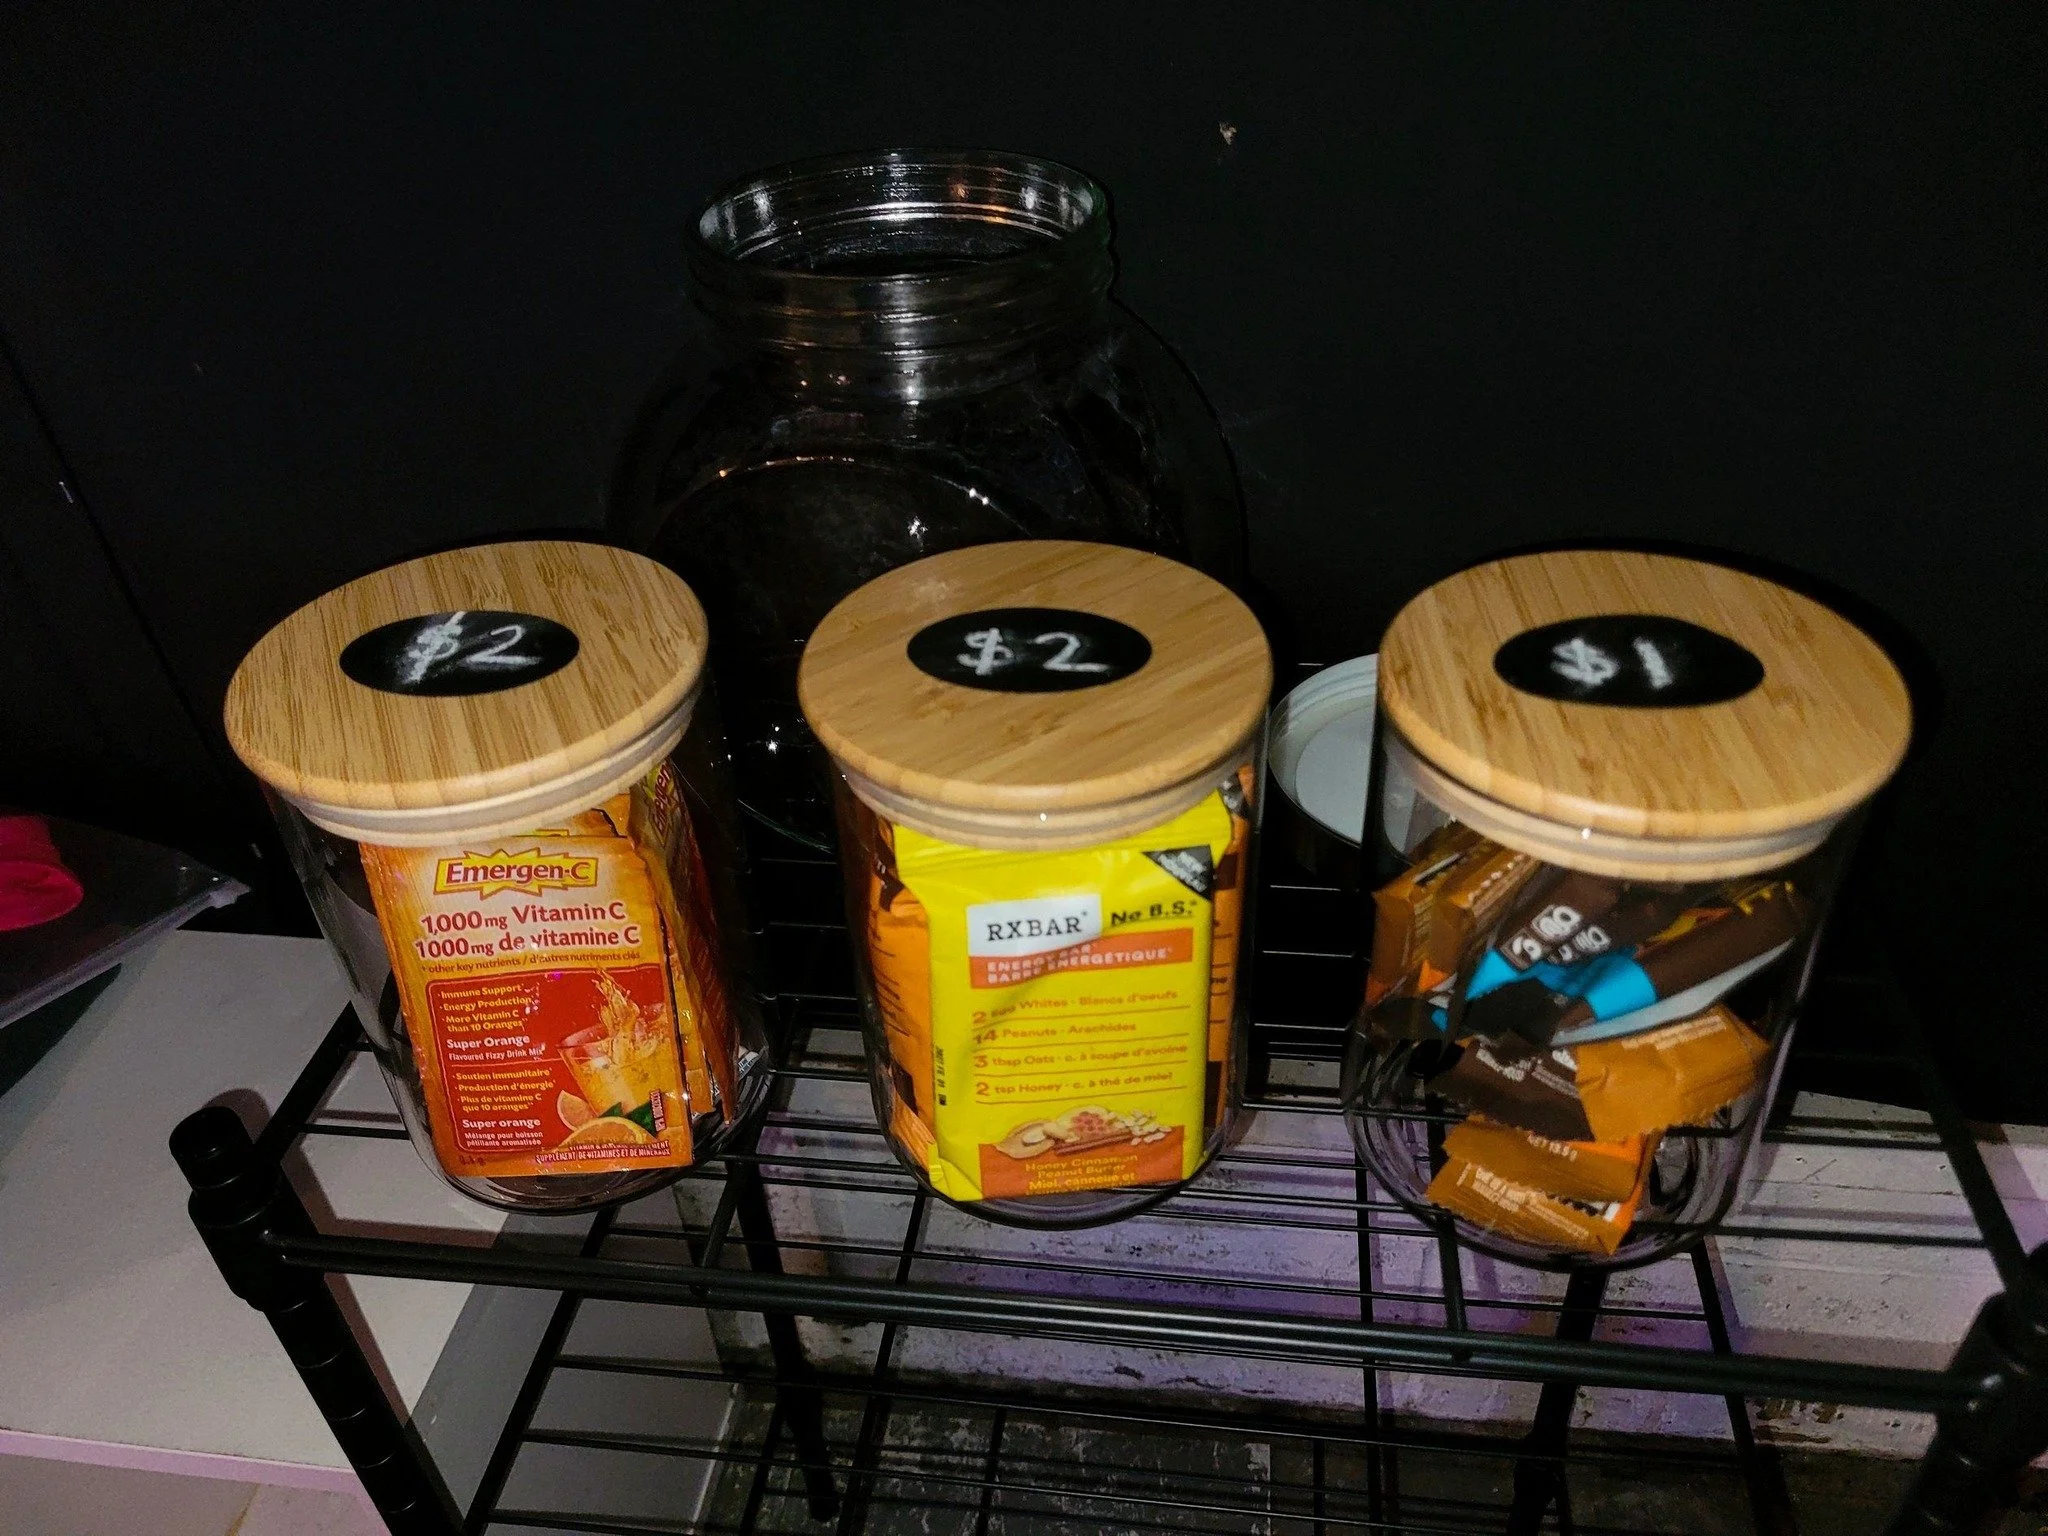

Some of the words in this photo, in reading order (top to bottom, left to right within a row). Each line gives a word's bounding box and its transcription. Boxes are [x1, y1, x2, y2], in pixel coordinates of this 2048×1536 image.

[446, 862, 591, 884] Emergen-C
[512, 903, 606, 924] Vitamin
[609, 902, 626, 919] C
[498, 932, 524, 951] de
[531, 928, 619, 948] vitamine
[624, 926, 640, 944] C
[456, 961, 473, 973] key
[476, 958, 520, 969] nutrients
[441, 991, 480, 999] Immune
[443, 1003, 476, 1012] Energy
[445, 1015, 470, 1023] More
[472, 1011, 511, 1022] Vitamin
[972, 1011, 987, 1024] 2
[1002, 1028, 1057, 1038] Peanuts
[1068, 1023, 1136, 1034] Arachides
[447, 1039, 481, 1051] Super
[484, 1035, 530, 1047] Orange
[448, 1052, 484, 1060] Flavoured
[486, 1050, 505, 1060] Fizzy
[507, 1048, 527, 1057] Drink
[974, 1055, 989, 1068] 3
[1024, 1055, 1054, 1065] Oats
[456, 1072, 491, 1080] Soutien
[459, 1083, 509, 1092] Production
[975, 1082, 990, 1096] 2
[1019, 1083, 1062, 1094] Honey
[494, 1094, 534, 1102] vitamine
[463, 1105, 479, 1113] que
[462, 1119, 497, 1130] Super
[499, 1119, 540, 1128] orange
